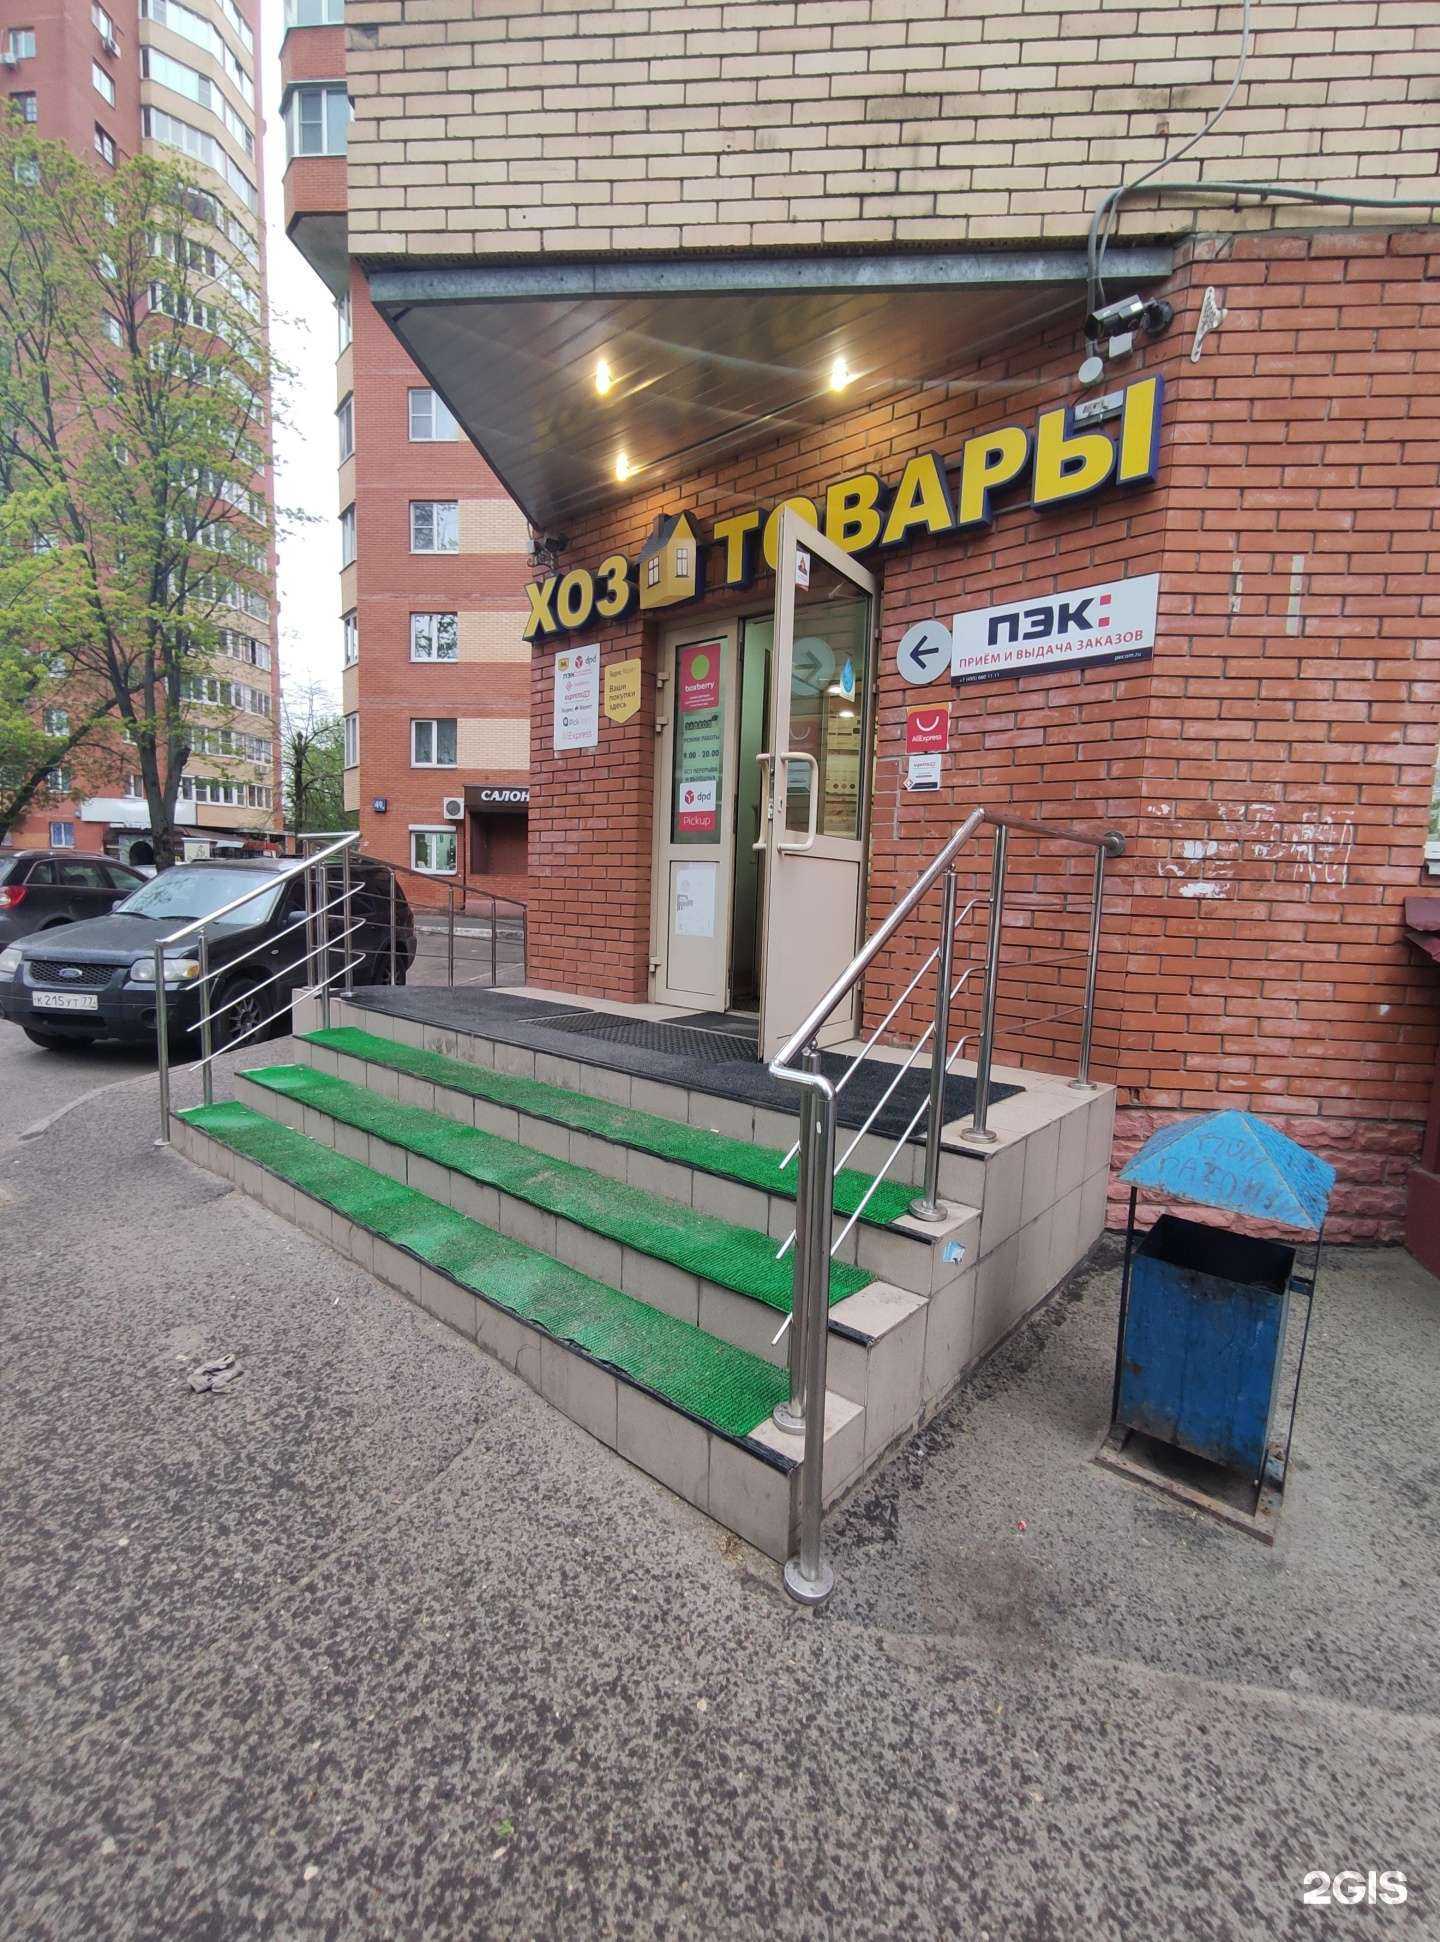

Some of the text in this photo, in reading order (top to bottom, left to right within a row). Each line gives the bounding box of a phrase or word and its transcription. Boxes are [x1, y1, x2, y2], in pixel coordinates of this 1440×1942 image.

[522, 554, 634, 641] ХОЗ
[959, 628, 1144, 669] ПРИЁМ И ВЫДАЧА ЗАКАЗОВ
[481, 790, 529, 802] САЛОН
[697, 791, 712, 803] dpd
[683, 815, 711, 828] Pickup
